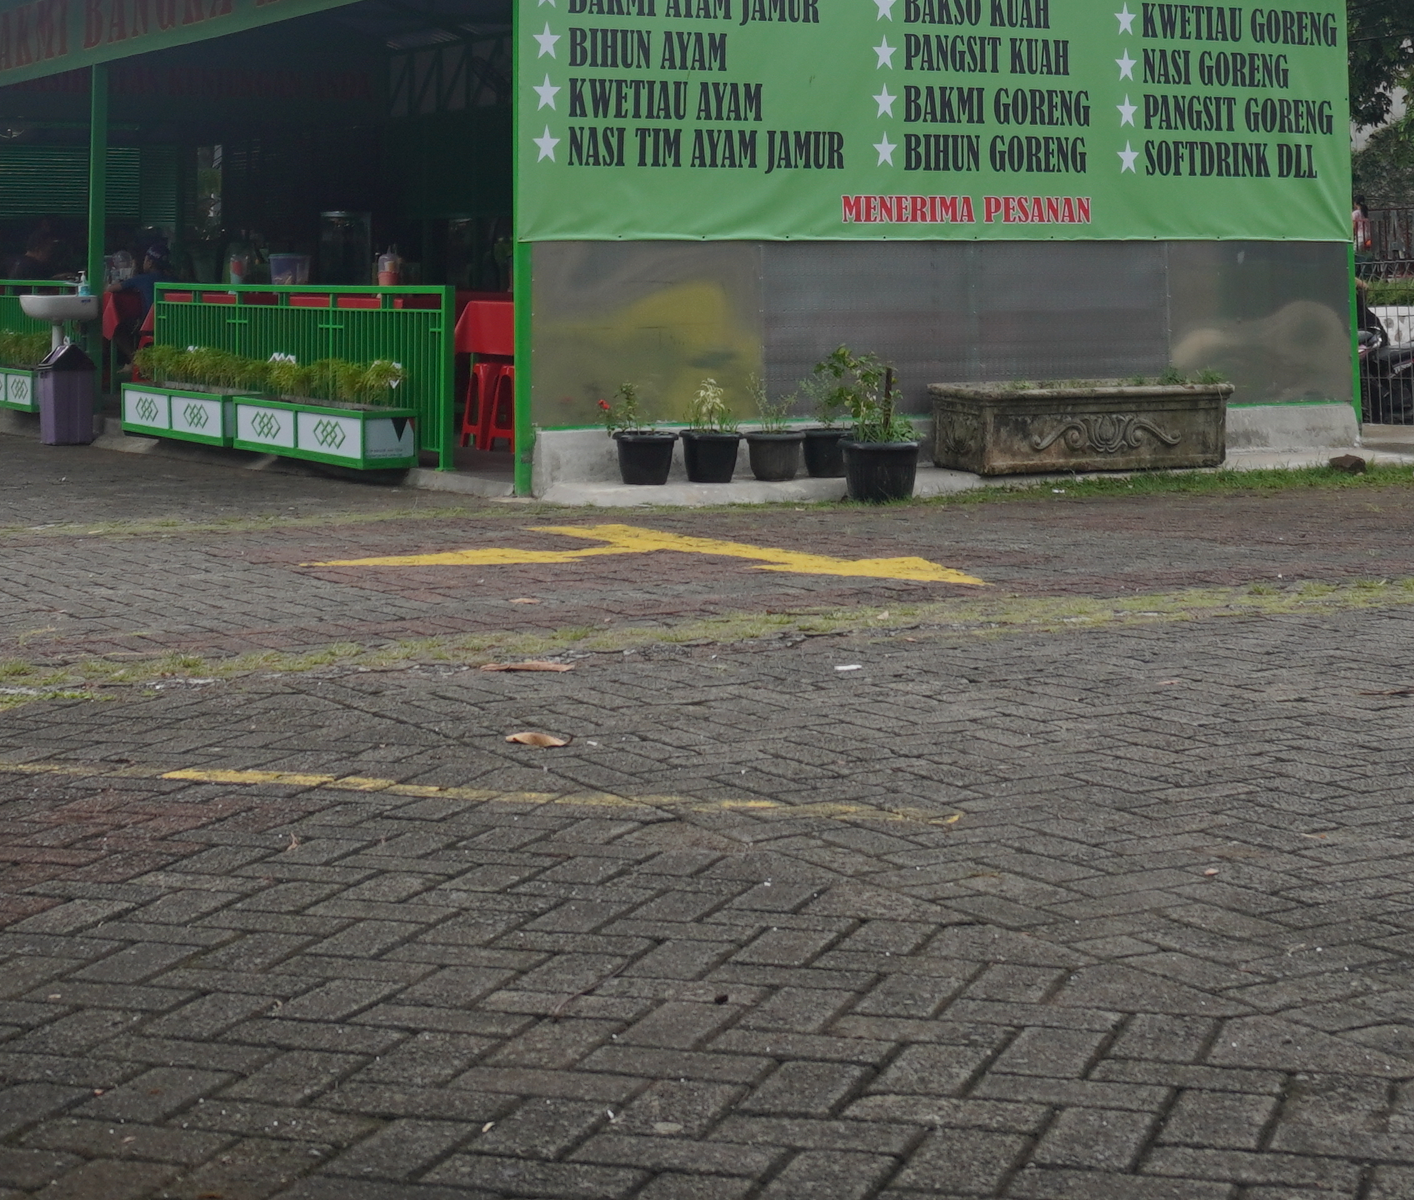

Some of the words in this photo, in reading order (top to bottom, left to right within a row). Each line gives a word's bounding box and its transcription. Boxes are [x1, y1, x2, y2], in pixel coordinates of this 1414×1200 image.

[1141, 2, 1243, 42] KWETIAU
[1250, 8, 1337, 47] GORENG
[568, 27, 652, 69] BIHUN
[660, 31, 728, 71] AYAM
[904, 33, 1001, 73] PANGSIT
[1009, 37, 1070, 76] KUAH
[1142, 48, 1191, 85] NASI
[1199, 50, 1289, 89] GORENG
[568, 78, 688, 120] KWETIAU
[696, 81, 763, 122] AYAM
[903, 85, 985, 124] BAKMI
[994, 87, 1091, 127] GORENG
[1143, 94, 1237, 132] PANGSIT
[1244, 97, 1334, 135] GORENG
[568, 126, 626, 167] NASI
[635, 128, 683, 168] TIM
[690, 129, 758, 169] AYAM
[764, 130, 845, 174] JAMUR
[904, 133, 980, 172] BIHUN
[989, 135, 1087, 174] GORENG
[1145, 140, 1271, 178] SOFTDRINK
[1277, 143, 1318, 179] DLL
[841, 194, 976, 224] MENERIMA
[983, 195, 1092, 224] PESANAN
